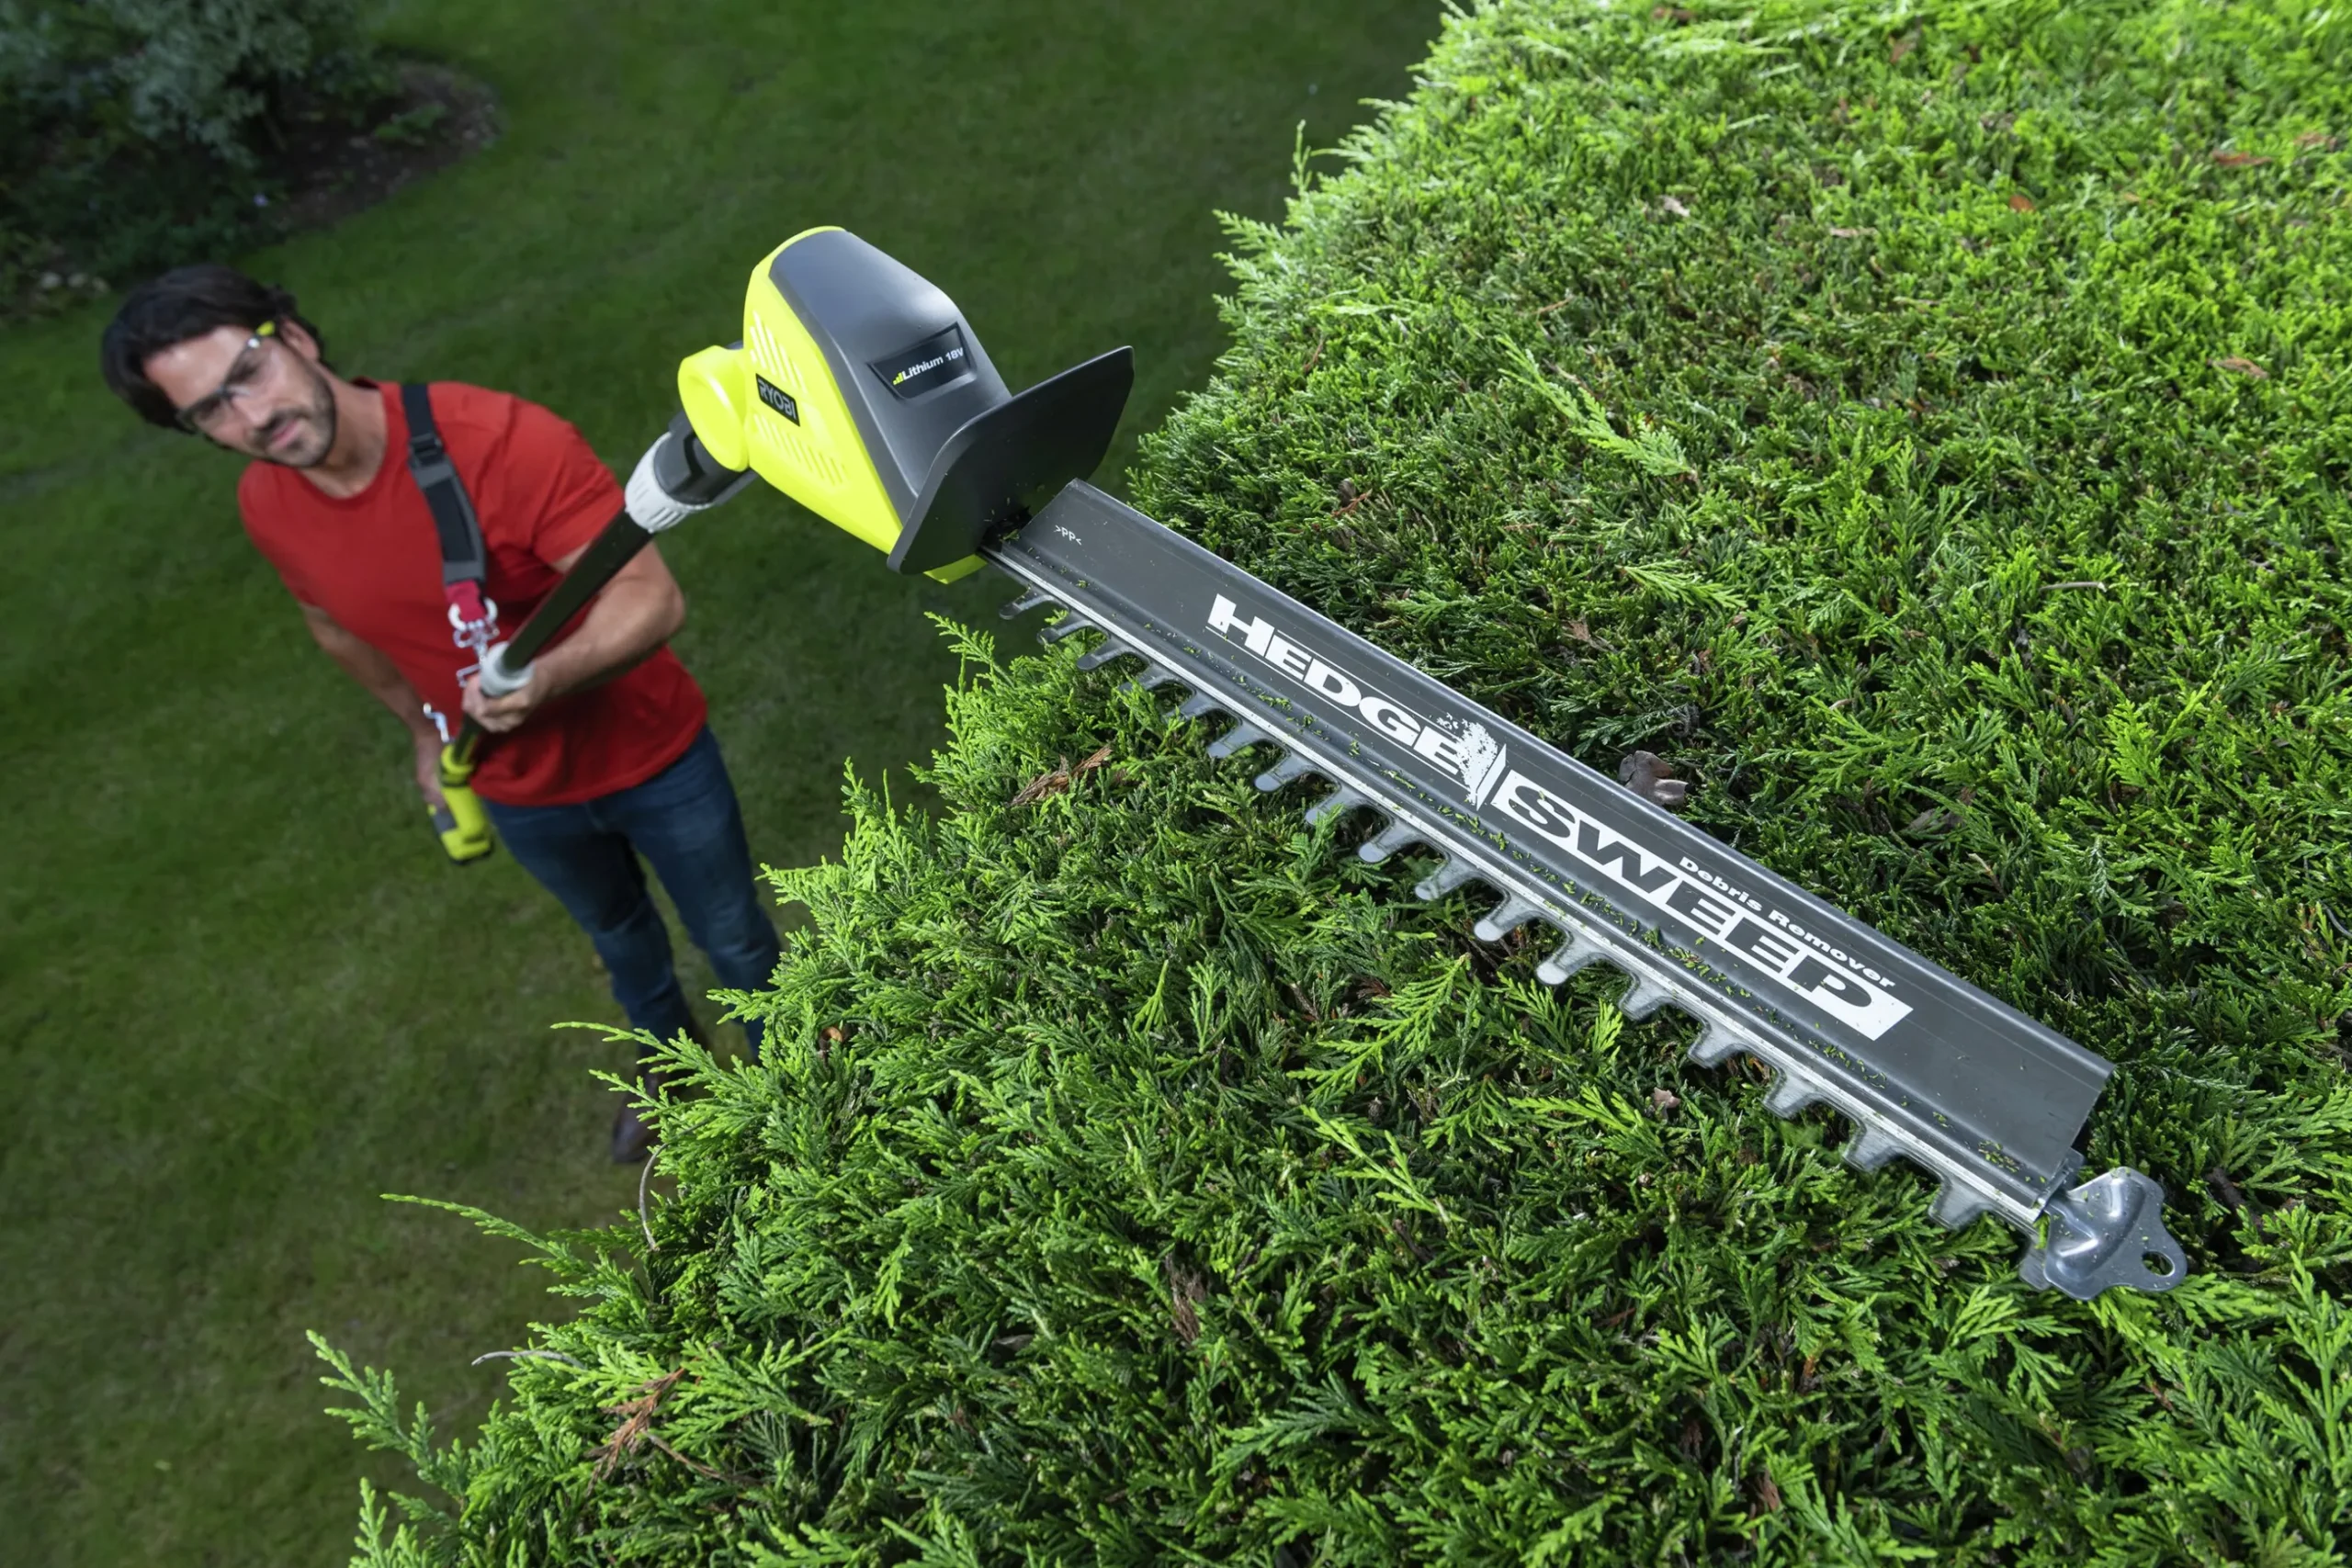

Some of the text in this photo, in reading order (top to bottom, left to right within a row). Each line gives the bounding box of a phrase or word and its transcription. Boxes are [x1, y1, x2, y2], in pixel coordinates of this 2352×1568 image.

[757, 378, 797, 421] RYOBI
[901, 347, 964, 381] Lithium 18V
[1206, 592, 1872, 1009] HEDGE SWEEP
[1679, 856, 1896, 988] Debris Remover
